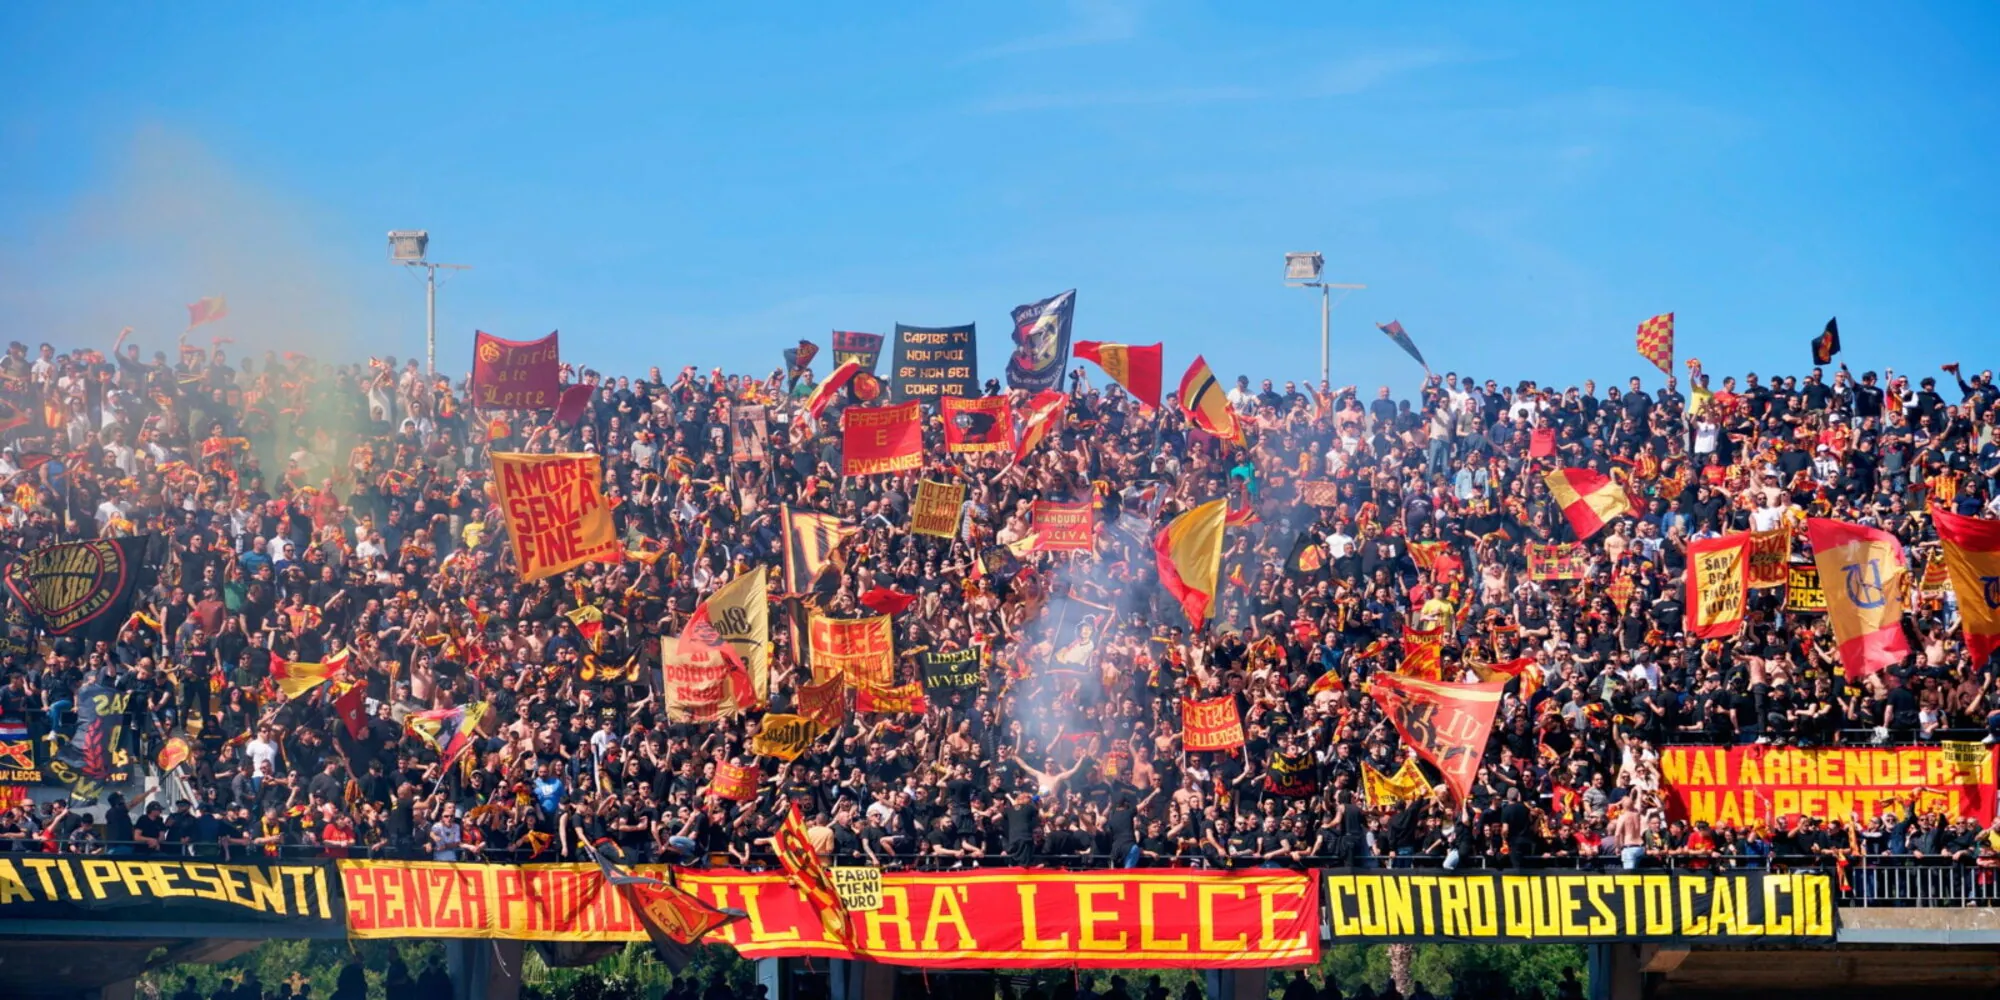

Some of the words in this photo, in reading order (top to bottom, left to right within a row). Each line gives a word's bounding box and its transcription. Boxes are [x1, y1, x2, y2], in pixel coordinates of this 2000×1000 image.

[904, 332, 948, 345] CAPIRE
[480, 341, 557, 366] Gloria
[907, 350, 931, 361] NON
[934, 350, 963, 360] PUOI
[900, 367, 916, 377] SE
[920, 367, 944, 378] NON
[948, 367, 970, 378] SEI
[905, 384, 937, 395] COME
[941, 384, 963, 395] NOI
[849, 404, 920, 427] PASSATO
[876, 430, 887, 446] E
[848, 452, 922, 472] AVVENIRE
[503, 458, 594, 497] AMORE
[922, 483, 932, 498] IO
[937, 486, 961, 501] PER
[509, 479, 598, 534] SENZA
[919, 498, 931, 513] TE
[916, 514, 956, 533] DORMO
[1036, 514, 1088, 525] MANDURIA
[518, 521, 613, 573] FINE...
[1535, 563, 1553, 574] NE
[1788, 589, 1827, 608] PRES
[927, 647, 977, 664] LIBERI
[950, 664, 958, 672] e
[1661, 748, 1728, 785] MAI
[11, 771, 42, 782] LECCE
[1690, 789, 1757, 827] MAI
[1774, 788, 1960, 827] PENTII
[836, 869, 879, 882] FABIO
[81, 860, 332, 919] PRESENTI
[837, 881, 880, 895] TIENI
[345, 867, 489, 930] SENZA
[497, 868, 664, 933] PADRO
[1328, 875, 1498, 937] CONTRO
[1503, 875, 1674, 938] QUESTO
[1679, 875, 1833, 937] CALCIO
[682, 881, 977, 951] ULRA'
[1017, 883, 1309, 952] LECCE
